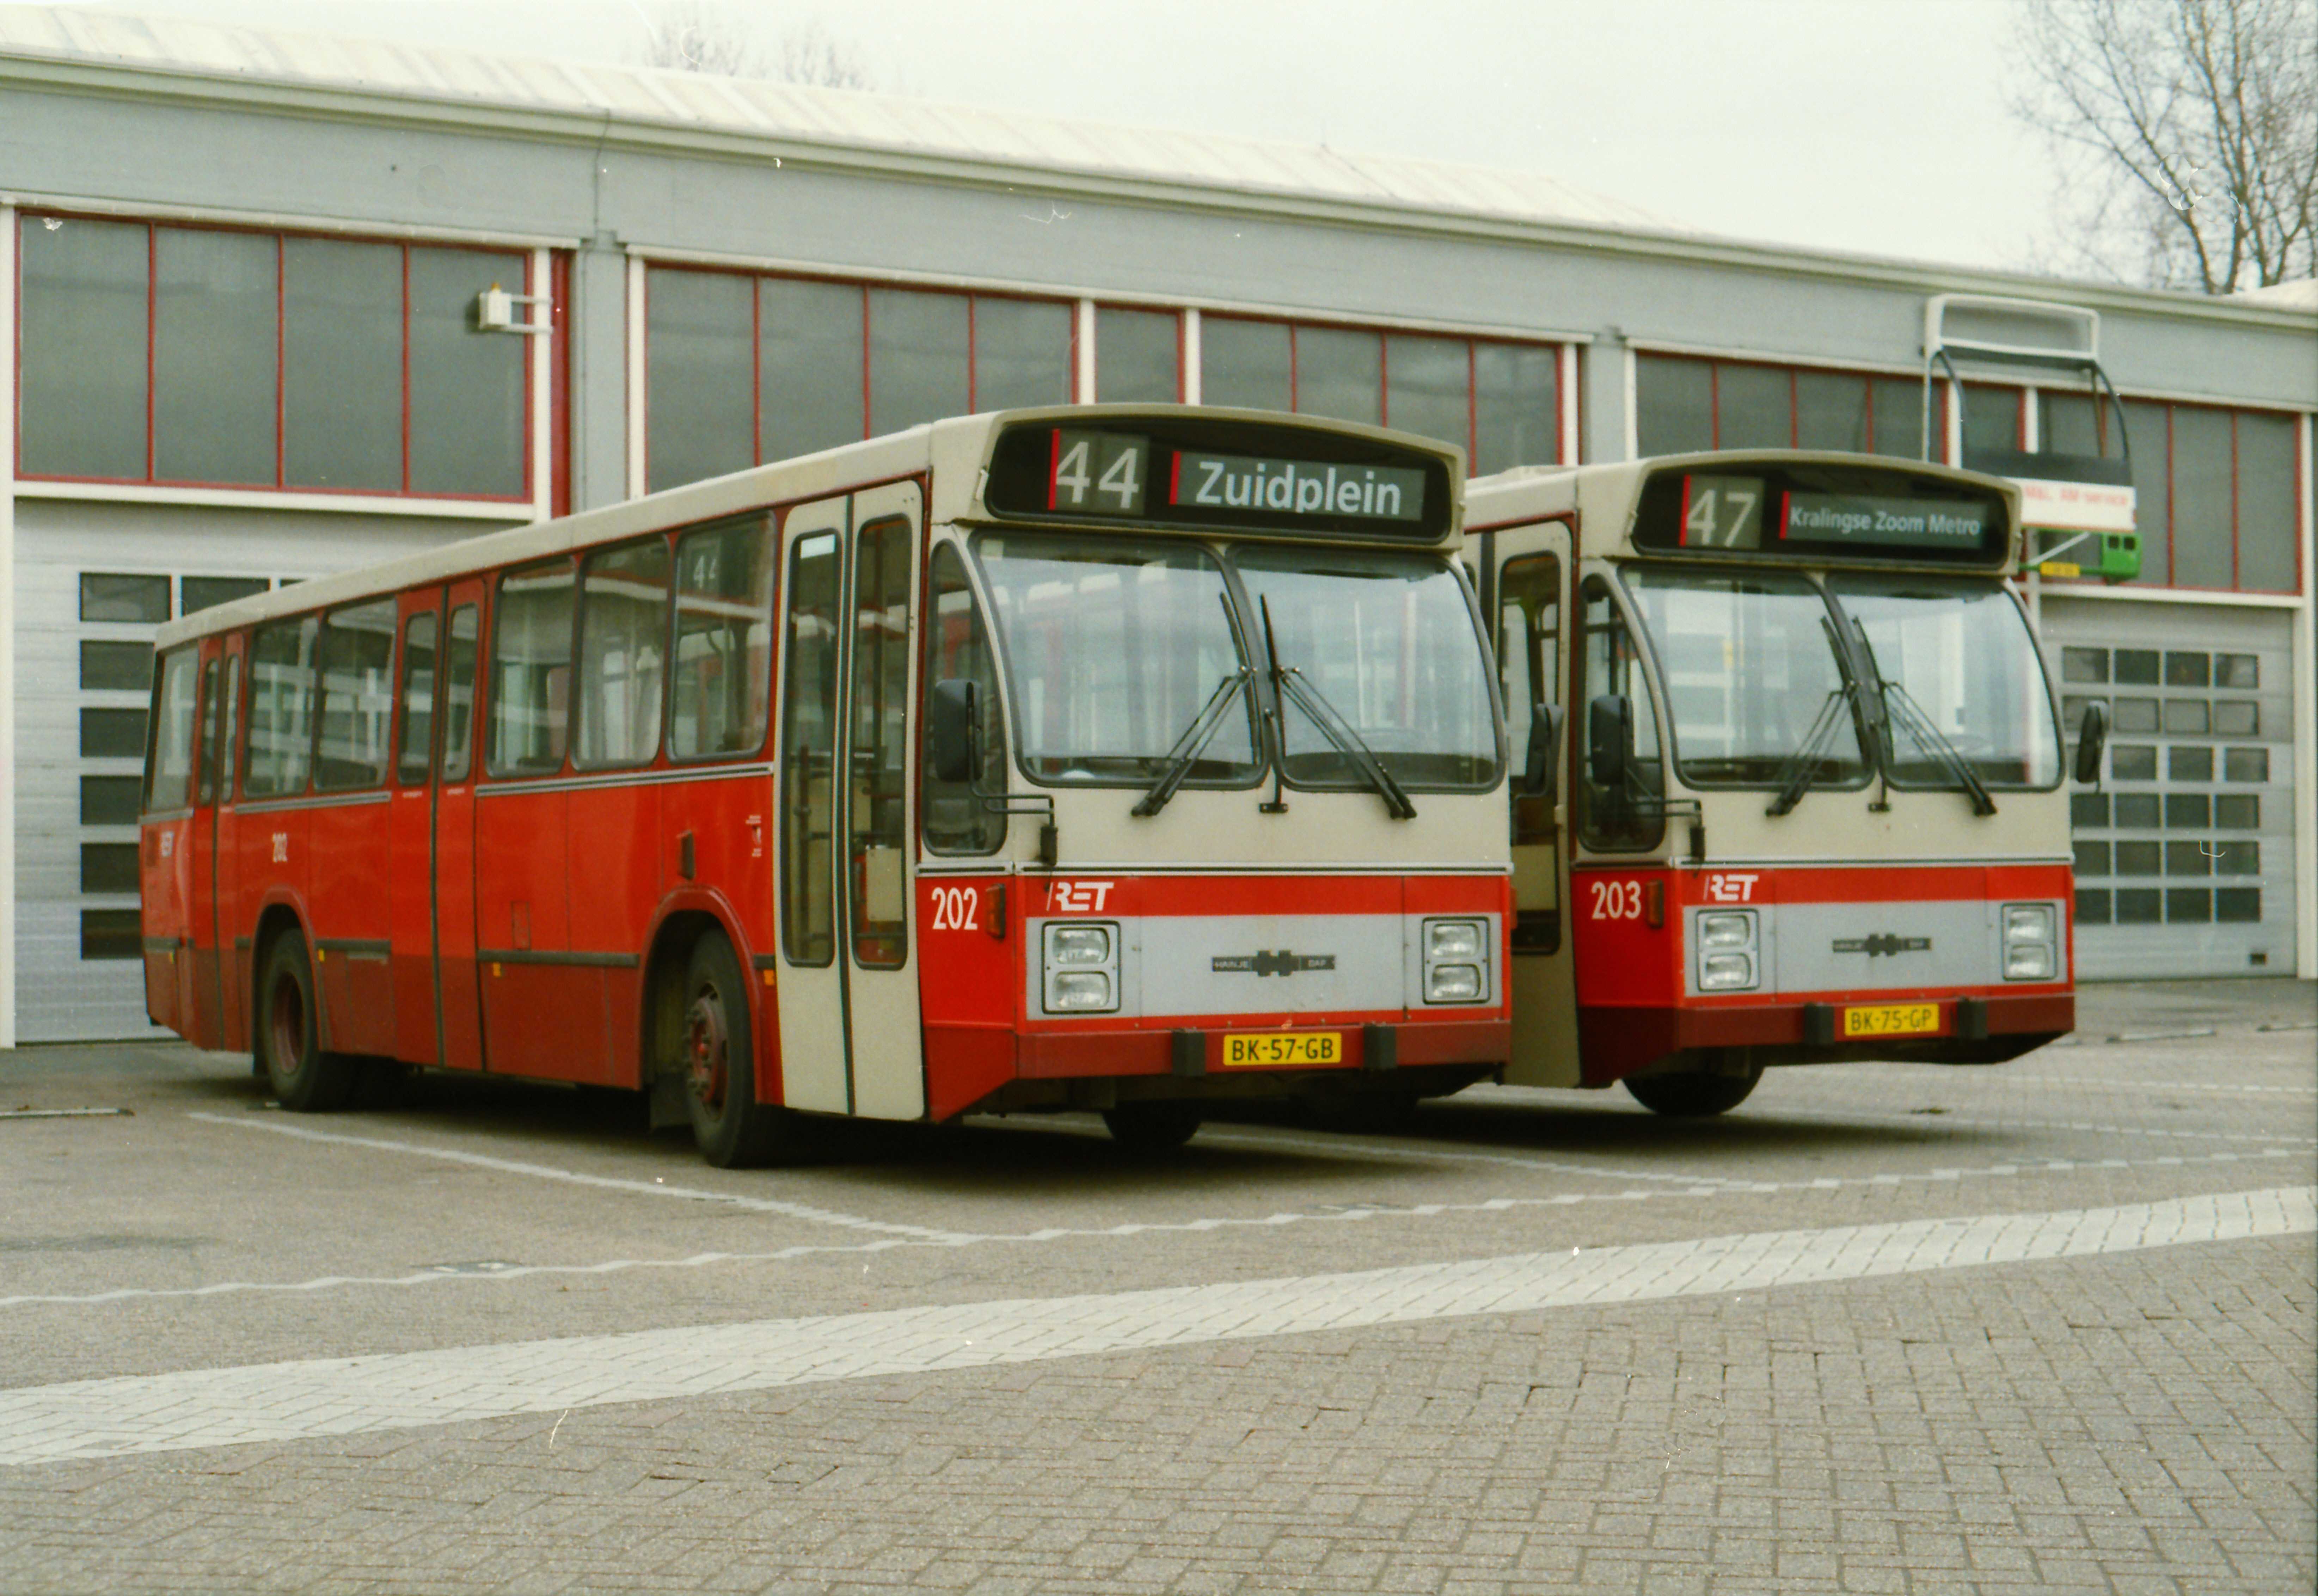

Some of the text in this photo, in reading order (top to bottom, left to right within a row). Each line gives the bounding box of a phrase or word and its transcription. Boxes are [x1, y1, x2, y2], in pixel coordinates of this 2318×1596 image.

[1056, 441, 1140, 509] 44
[1196, 461, 1400, 515] Zuidplein
[1687, 489, 1756, 547] 47
[1790, 507, 1981, 535] Kralingse Zoom Metro
[1055, 882, 1114, 911] RET
[1592, 881, 1641, 919] 203
[1711, 874, 1758, 901] RET
[931, 887, 978, 929] 202
[1851, 1008, 1932, 1031] BK-75-GP
[1232, 1038, 1333, 1061] BK-57-GB
